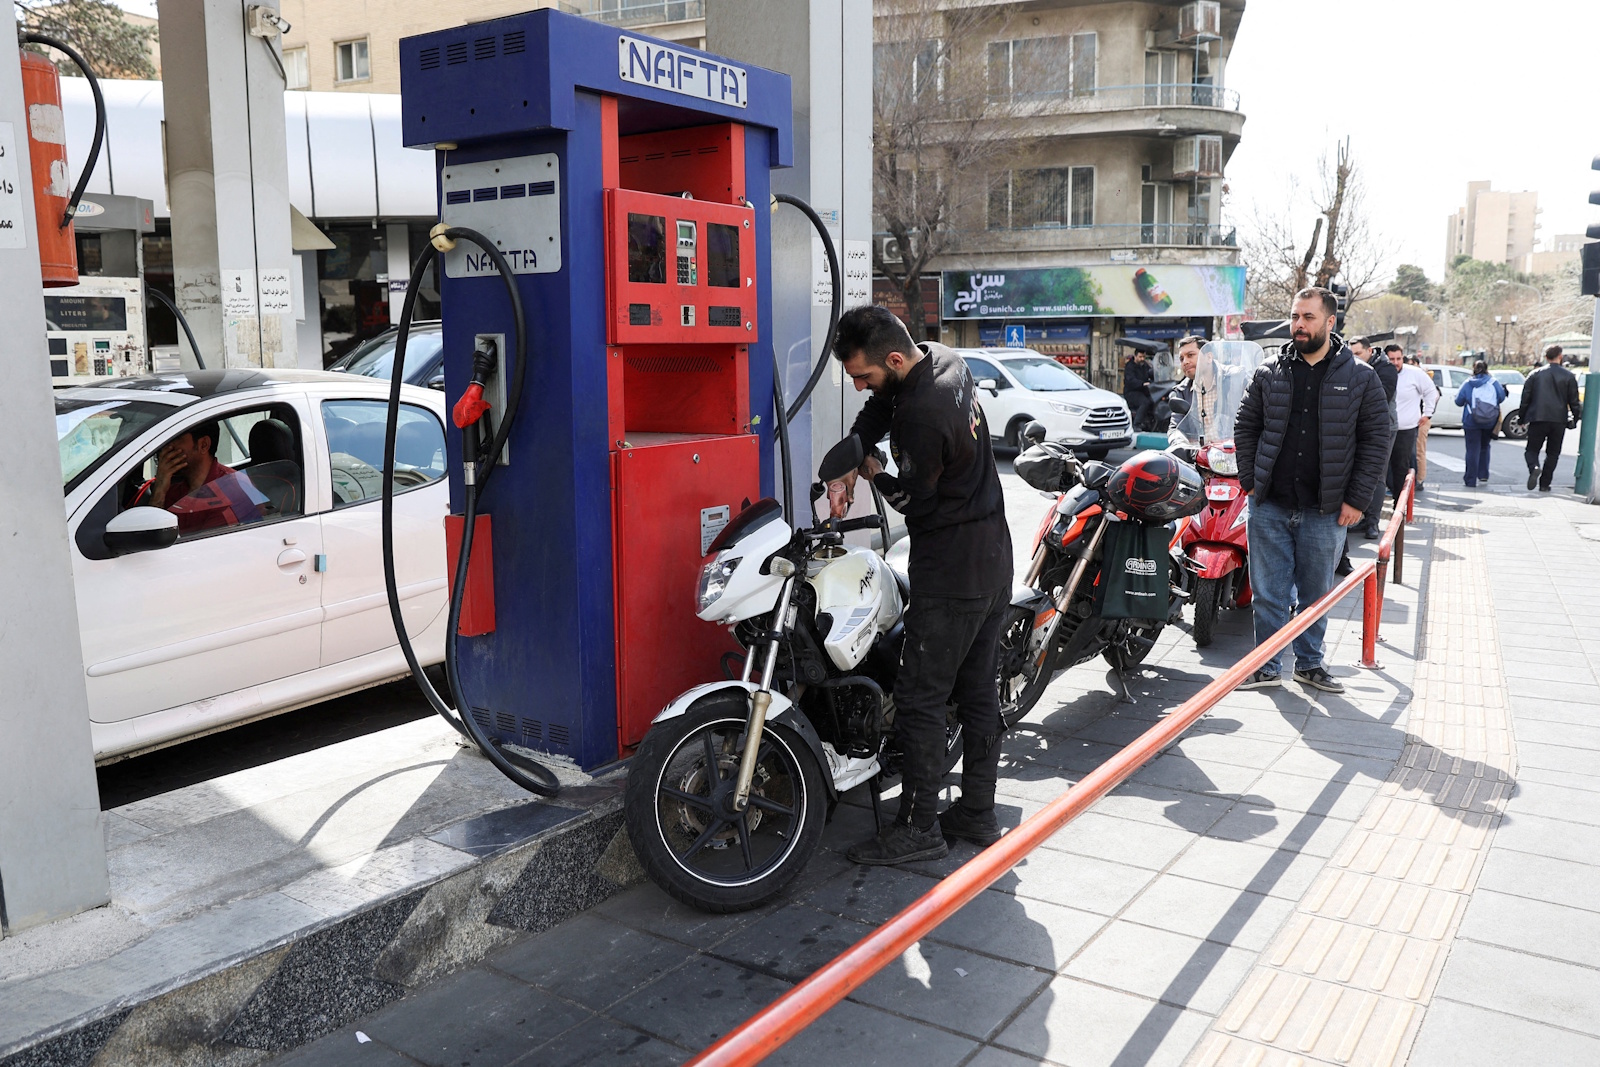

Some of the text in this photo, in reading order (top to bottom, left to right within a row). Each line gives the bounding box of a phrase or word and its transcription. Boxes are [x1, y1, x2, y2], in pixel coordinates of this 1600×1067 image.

[629, 42, 739, 103] NAFTA
[970, 273, 1005, 290] سن
[954, 288, 982, 312] ایچ
[1033, 304, 1093, 312] www.sunich.org
